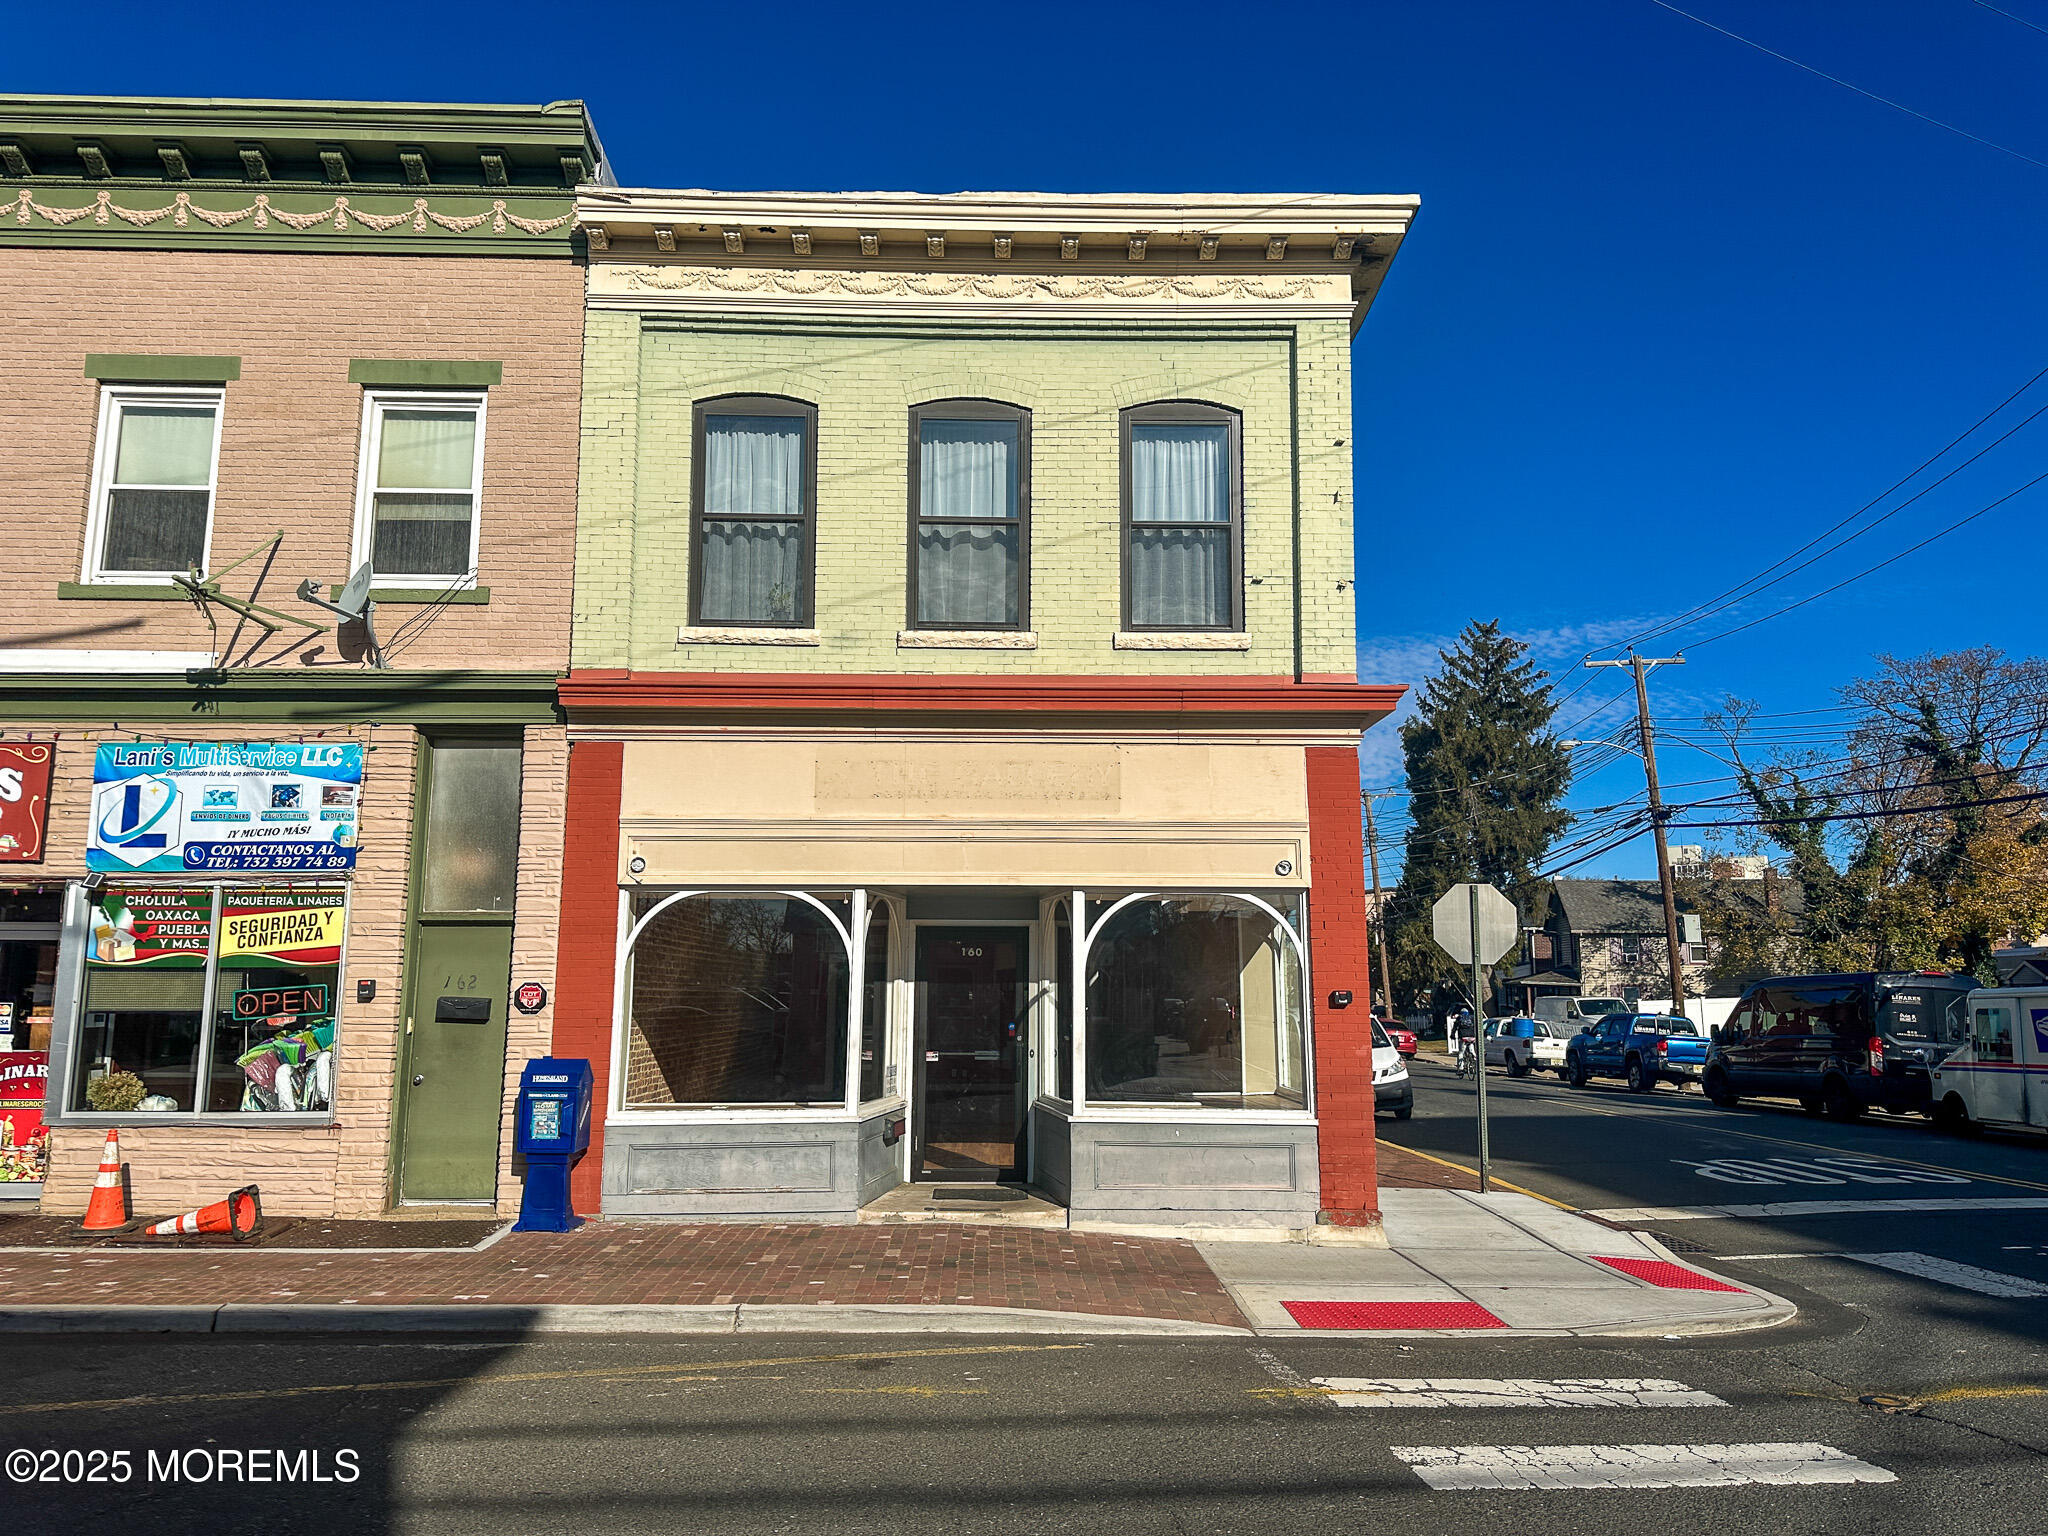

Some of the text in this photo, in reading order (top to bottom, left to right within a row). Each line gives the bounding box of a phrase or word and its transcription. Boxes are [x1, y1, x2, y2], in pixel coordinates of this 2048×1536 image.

[179, 746, 297, 767] Multiservice
[301, 746, 343, 767] LLC
[165, 769, 207, 778] Simplificando
[217, 769, 231, 779] vida,
[242, 769, 265, 777] servicio
[119, 785, 167, 848] L
[241, 828, 279, 838] MUCHO
[283, 824, 312, 835] MÁS!
[210, 844, 337, 857] CONTACTANOS AL
[206, 856, 347, 868] TEL: 732 397 74 89
[125, 895, 188, 906] CHOLULA
[227, 896, 343, 906] PAQUETERIA LINARES
[145, 910, 200, 921] OAXACA
[158, 924, 209, 935] PUEBLA
[229, 911, 334, 936] SEGURIDAD Y
[237, 926, 324, 949] CONFIANZA
[159, 939, 209, 949] Y MAS...
[961, 947, 983, 957] 160
[443, 974, 477, 990] 162
[237, 989, 322, 1015] OPEN
